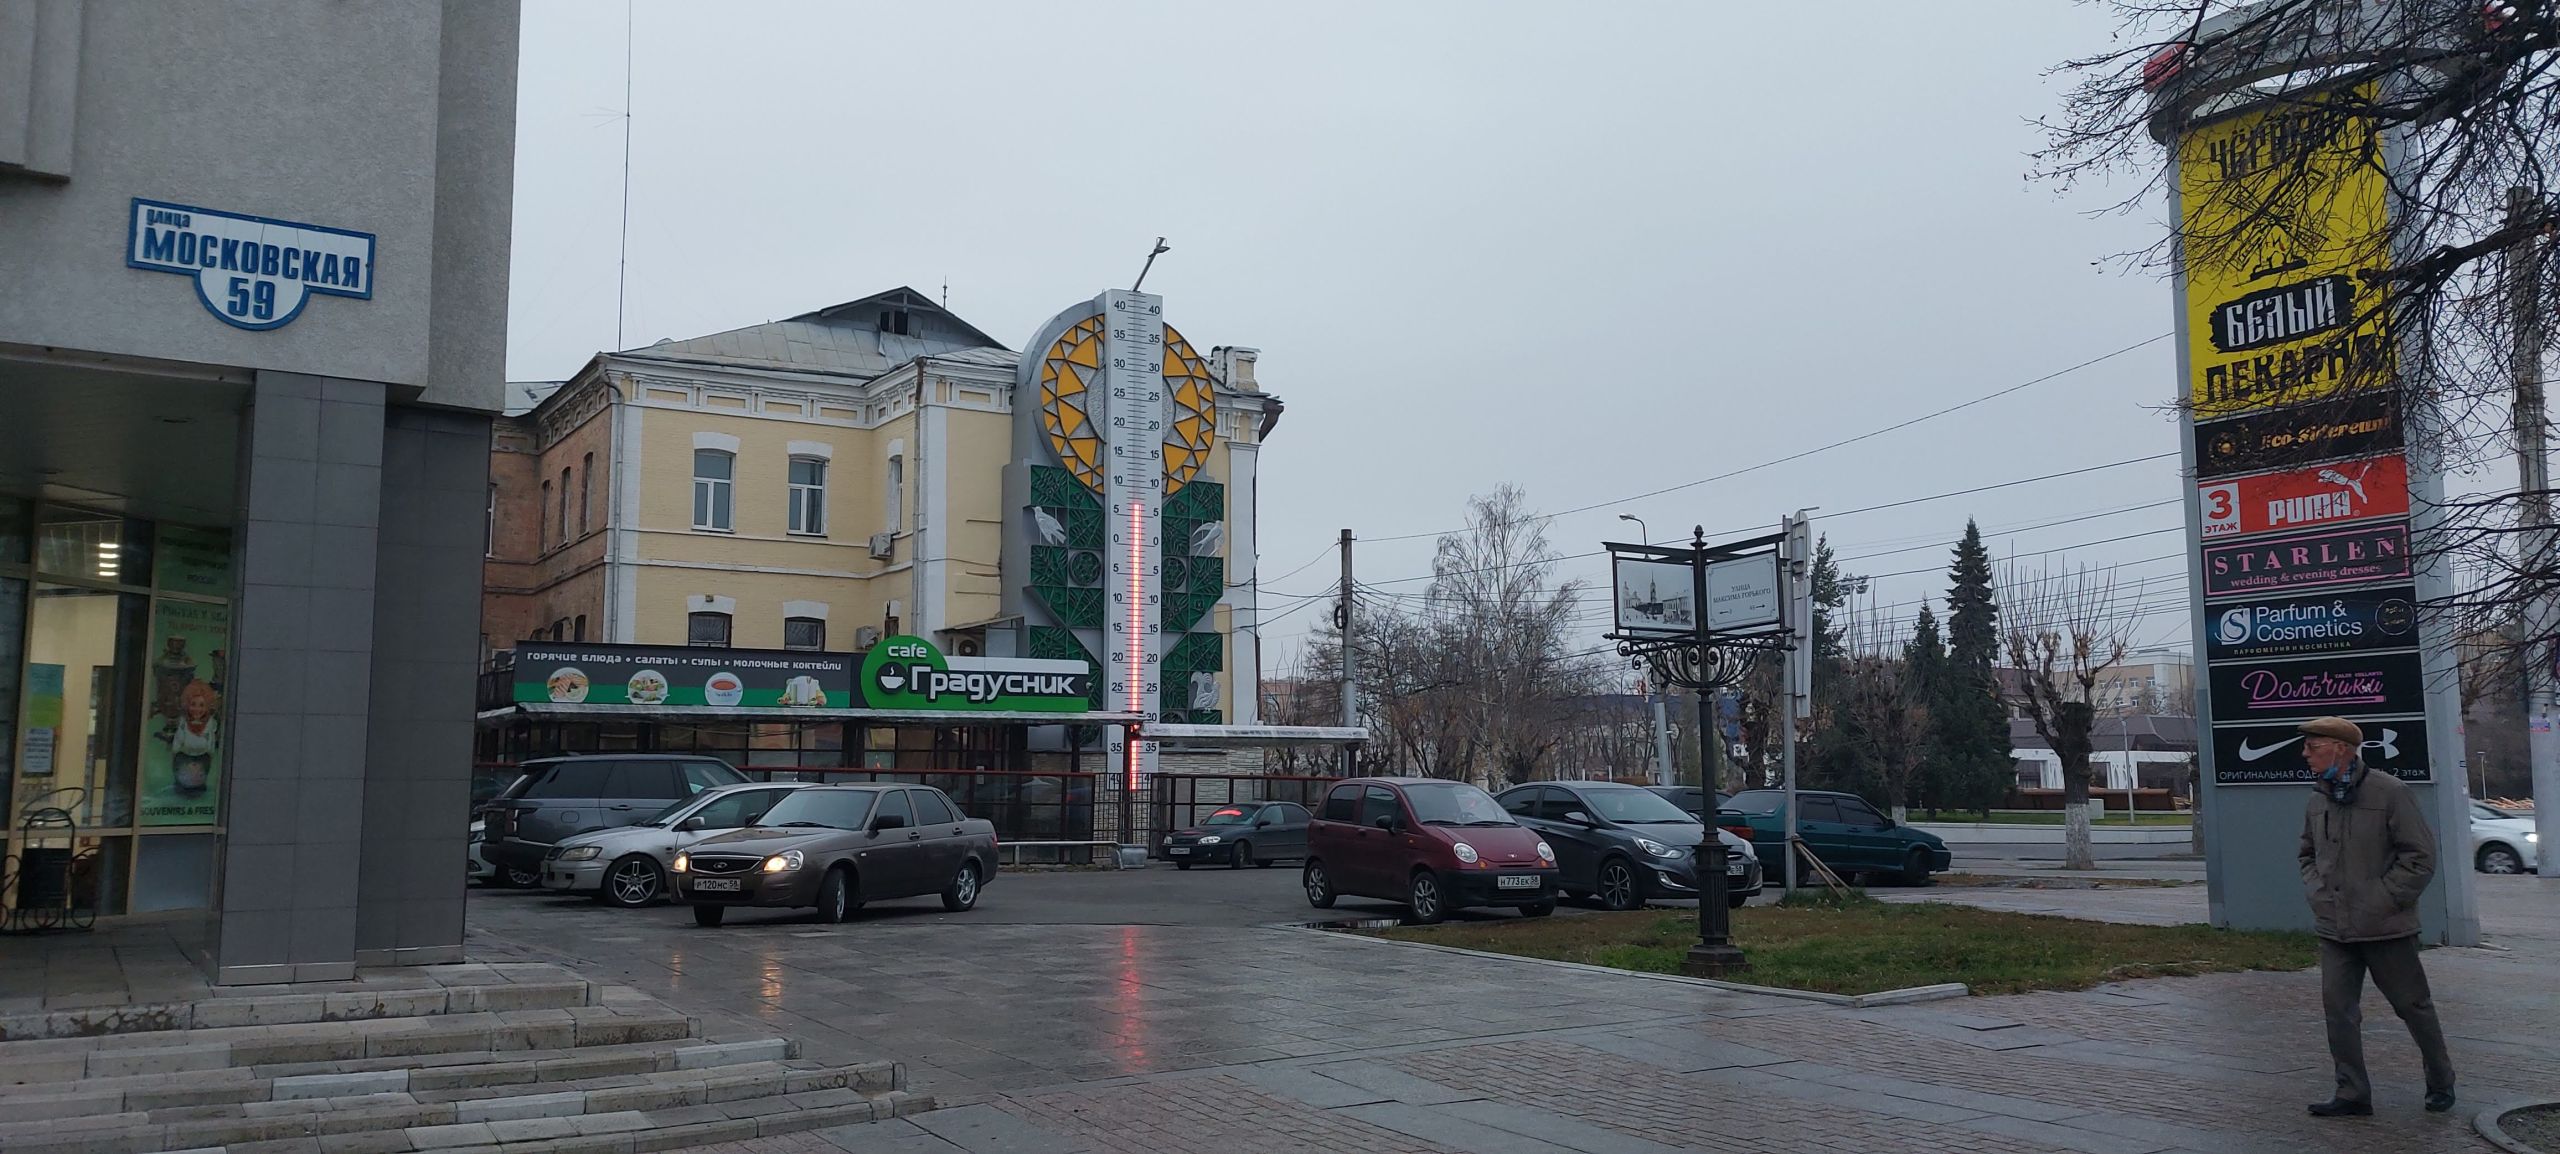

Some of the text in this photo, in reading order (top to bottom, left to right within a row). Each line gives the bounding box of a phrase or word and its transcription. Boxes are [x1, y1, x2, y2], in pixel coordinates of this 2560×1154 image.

[143, 226, 360, 289] МОСКОВСКАЯ
[227, 276, 276, 320] 59
[1114, 301, 1126, 310] 40
[1149, 305, 1161, 315] 40
[2226, 277, 2336, 348] БЕЛЫЙ
[1114, 330, 1126, 339] 35
[1149, 334, 1161, 343] 35
[1114, 359, 1126, 368] 30
[1149, 363, 1160, 372] 30
[1114, 388, 1126, 397] 25
[1149, 392, 1160, 401] 25
[1114, 417, 1126, 426] 20
[1149, 421, 1160, 430] 20
[1114, 447, 1124, 456] 15
[1150, 450, 1160, 459] 15
[1114, 476, 1123, 485] 10
[1150, 479, 1159, 488] 10
[2208, 489, 2232, 520] 3
[2268, 490, 2351, 526] PUMA
[1113, 505, 1119, 514] 5
[1153, 508, 1159, 517] 5
[2204, 521, 2238, 534] ЭТАЖ
[1113, 534, 1119, 543] 0
[1153, 537, 1159, 546] 0
[2215, 537, 2396, 577] STARLEN
[1113, 564, 1119, 573] 5
[1153, 566, 1159, 575] 5
[2231, 565, 2382, 588] wedding & evening dresses
[1113, 593, 1123, 602] 10
[1149, 595, 1159, 604] 10
[2256, 600, 2347, 624] Parfum &
[1112, 623, 1122, 632] 15
[1149, 624, 1158, 633] 15
[2256, 619, 2363, 642] Cosmetics
[2300, 640, 2352, 651] КОСМЕТИКА
[887, 643, 928, 658] cafe
[1112, 652, 1124, 662] 20
[1147, 653, 1158, 663] 20
[911, 665, 1075, 701] Градусник
[1112, 682, 1124, 692] 25
[1147, 683, 1158, 692] 25
[2241, 670, 2384, 700] Дольчики
[1110, 742, 1122, 752] 35
[1145, 742, 1157, 752] 35
[2219, 769, 2320, 780] ОРИГИНАЛЬНАЯ ОДЕ
[2393, 767, 2399, 777] 2
